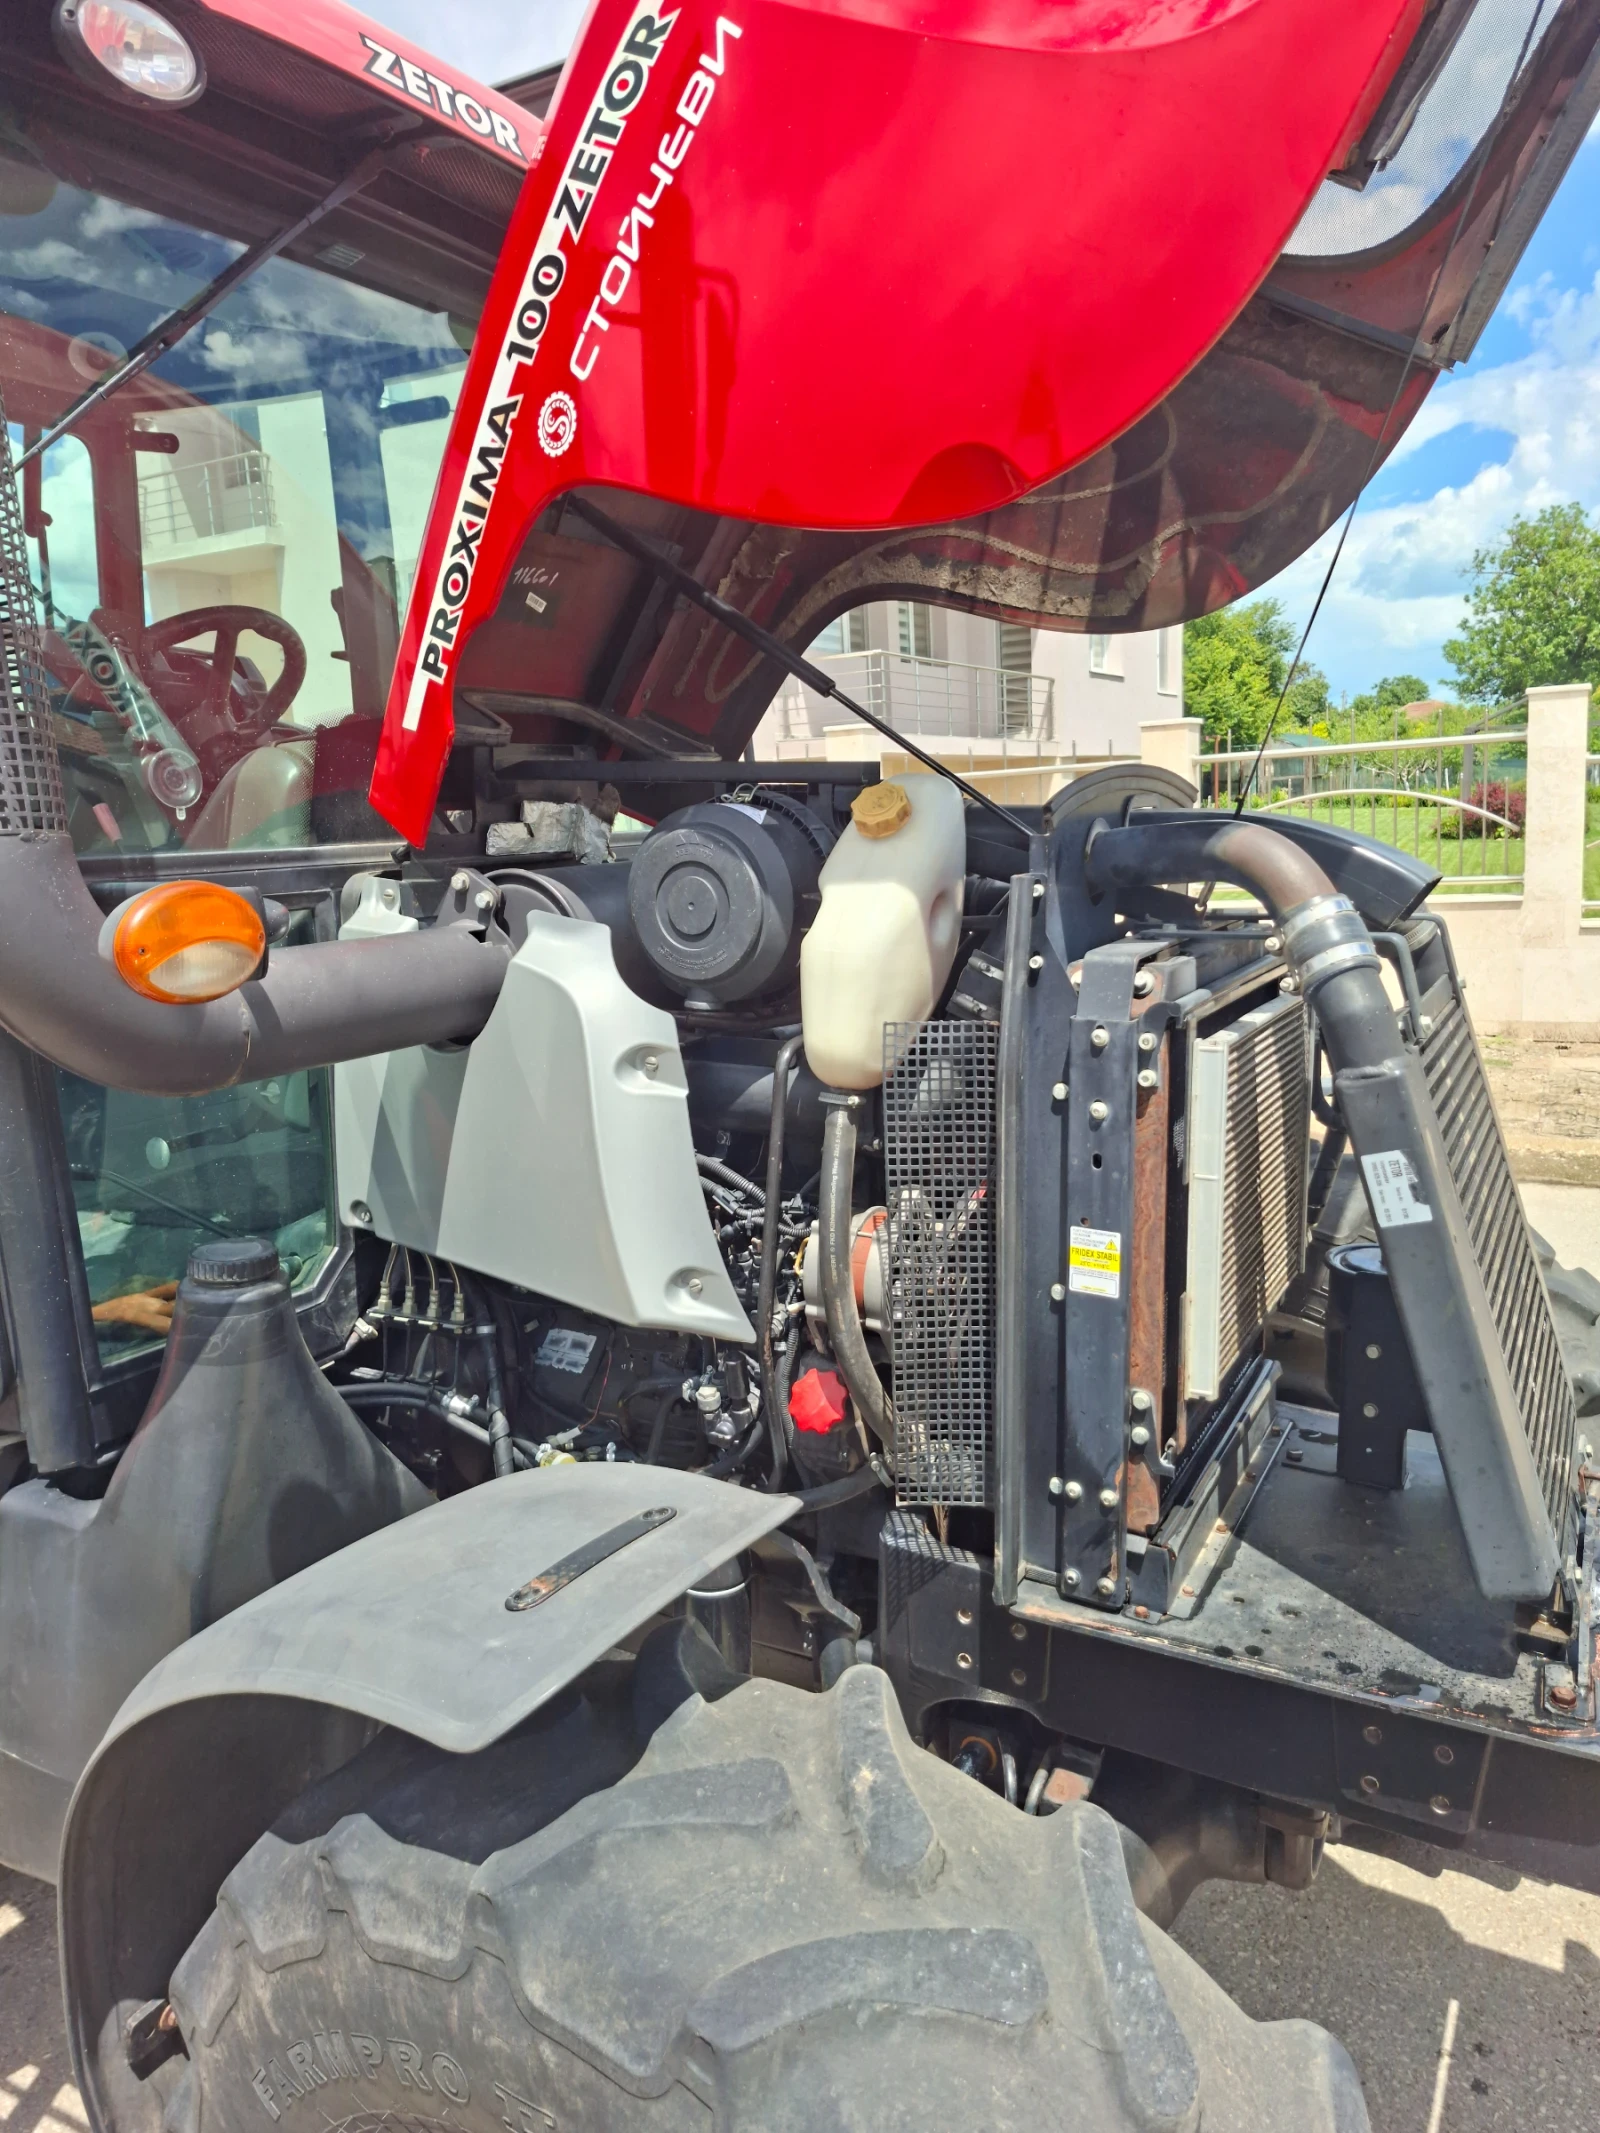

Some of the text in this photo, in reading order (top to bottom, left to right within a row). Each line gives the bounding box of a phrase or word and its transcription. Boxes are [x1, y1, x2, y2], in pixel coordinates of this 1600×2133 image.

[360, 34, 526, 159] ZETOR
[569, 15, 743, 382] СТОЙЧЕВИ
[421, 13, 675, 680] PROXIMA 100 ZETOR
[1071, 1247, 1094, 1257] FRIDEX
[1097, 1251, 1118, 1261] STABIL
[251, 2029, 471, 2122] FARMPRO
